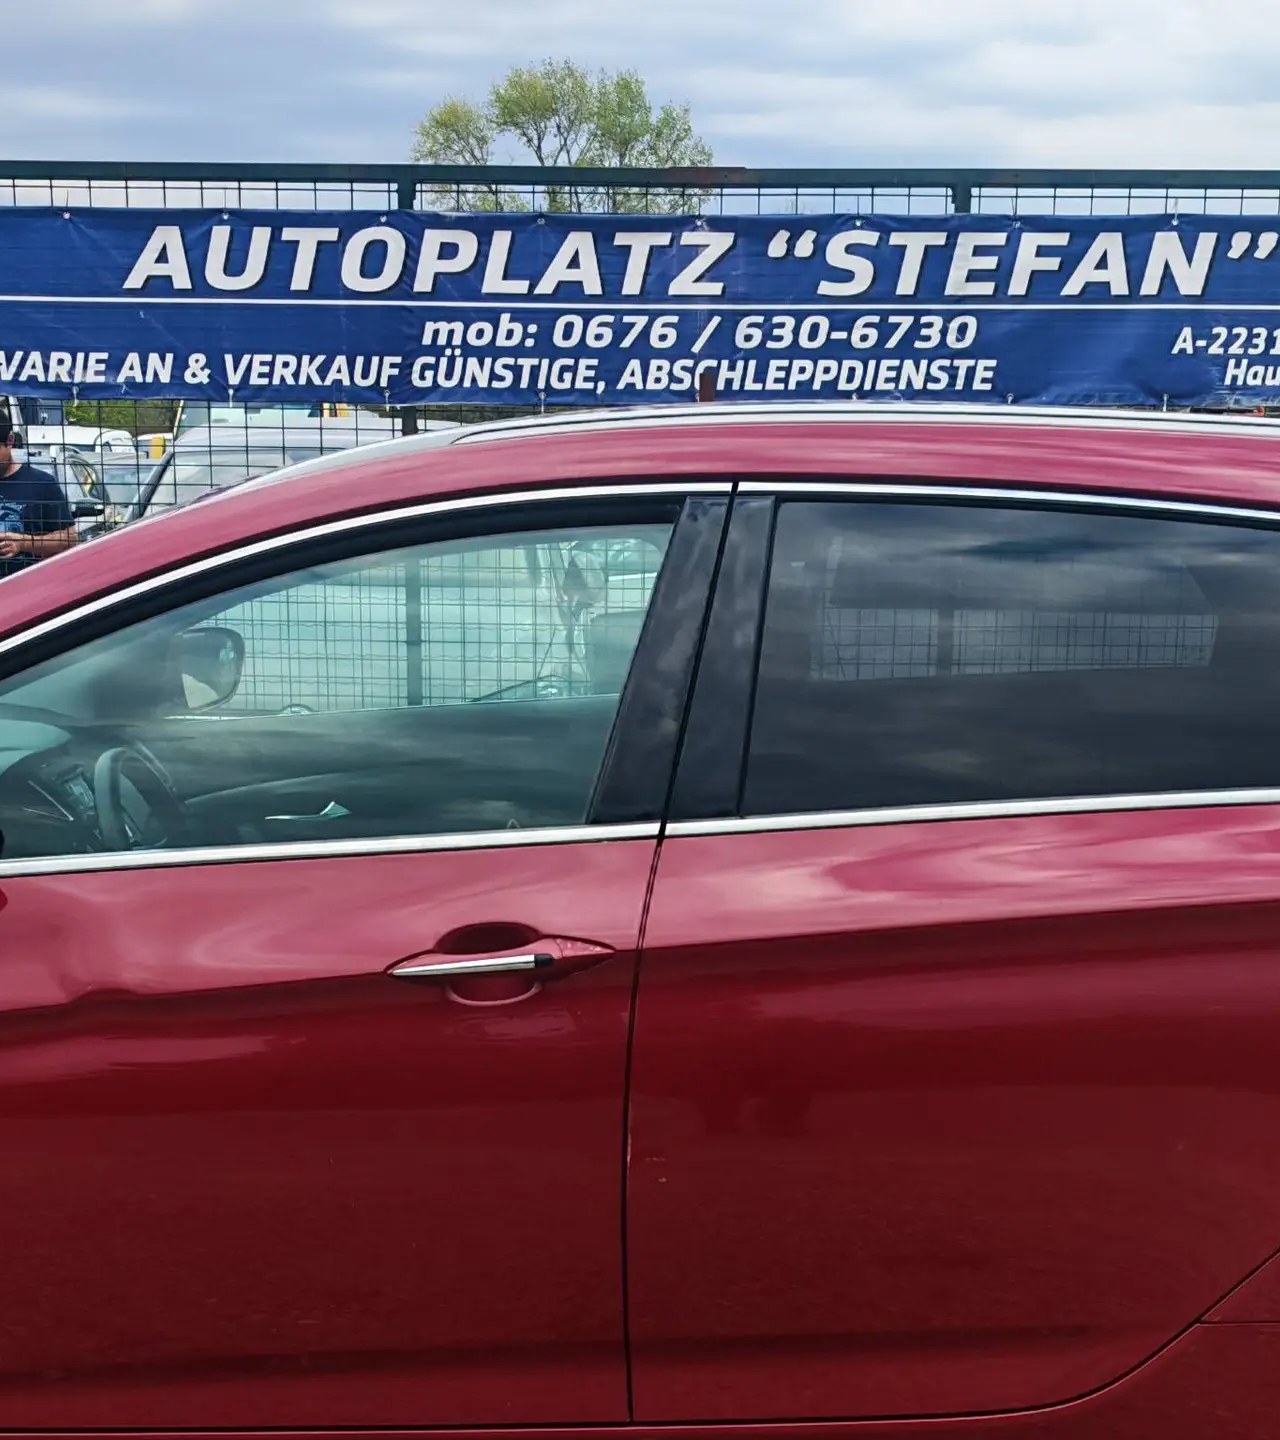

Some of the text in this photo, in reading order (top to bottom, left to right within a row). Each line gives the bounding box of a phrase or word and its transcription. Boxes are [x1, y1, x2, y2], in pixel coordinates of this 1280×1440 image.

[122, 225, 735, 296] AUTOPLATZ
[421, 312, 979, 355] mob: 0676 / 630-6730
[117, 351, 174, 384] AN
[183, 352, 211, 385] &
[225, 353, 402, 388] VERKAUF
[411, 348, 606, 395] GÜNSTIGE,
